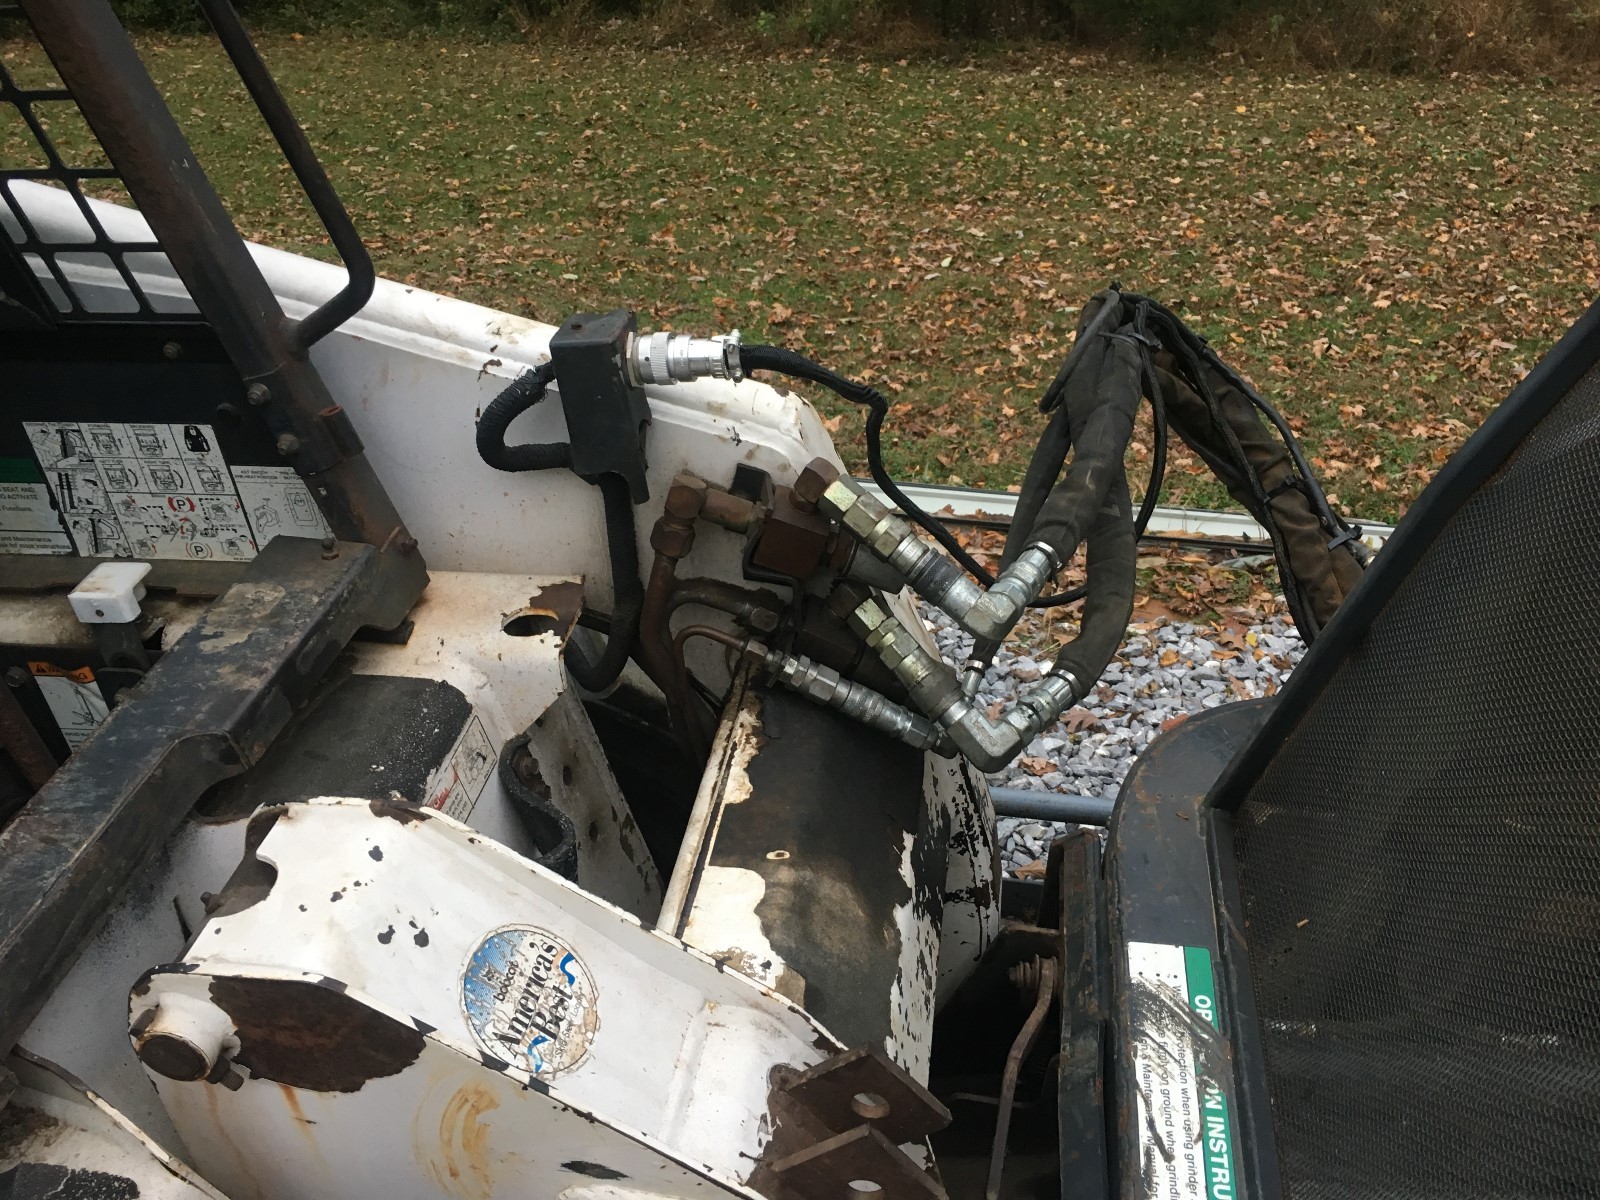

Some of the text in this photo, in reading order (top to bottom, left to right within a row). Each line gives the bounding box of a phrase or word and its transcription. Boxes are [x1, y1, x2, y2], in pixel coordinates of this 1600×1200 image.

[492, 939, 559, 1060] America's
[530, 984, 573, 1041] Best
[1160, 1088, 1174, 1127] ground
[1180, 1087, 1192, 1116] when
[1165, 1129, 1176, 1158] whe
[1182, 1118, 1194, 1150] using
[1184, 1153, 1199, 1197] grinder
[1207, 1116, 1232, 1200] INSTRU
